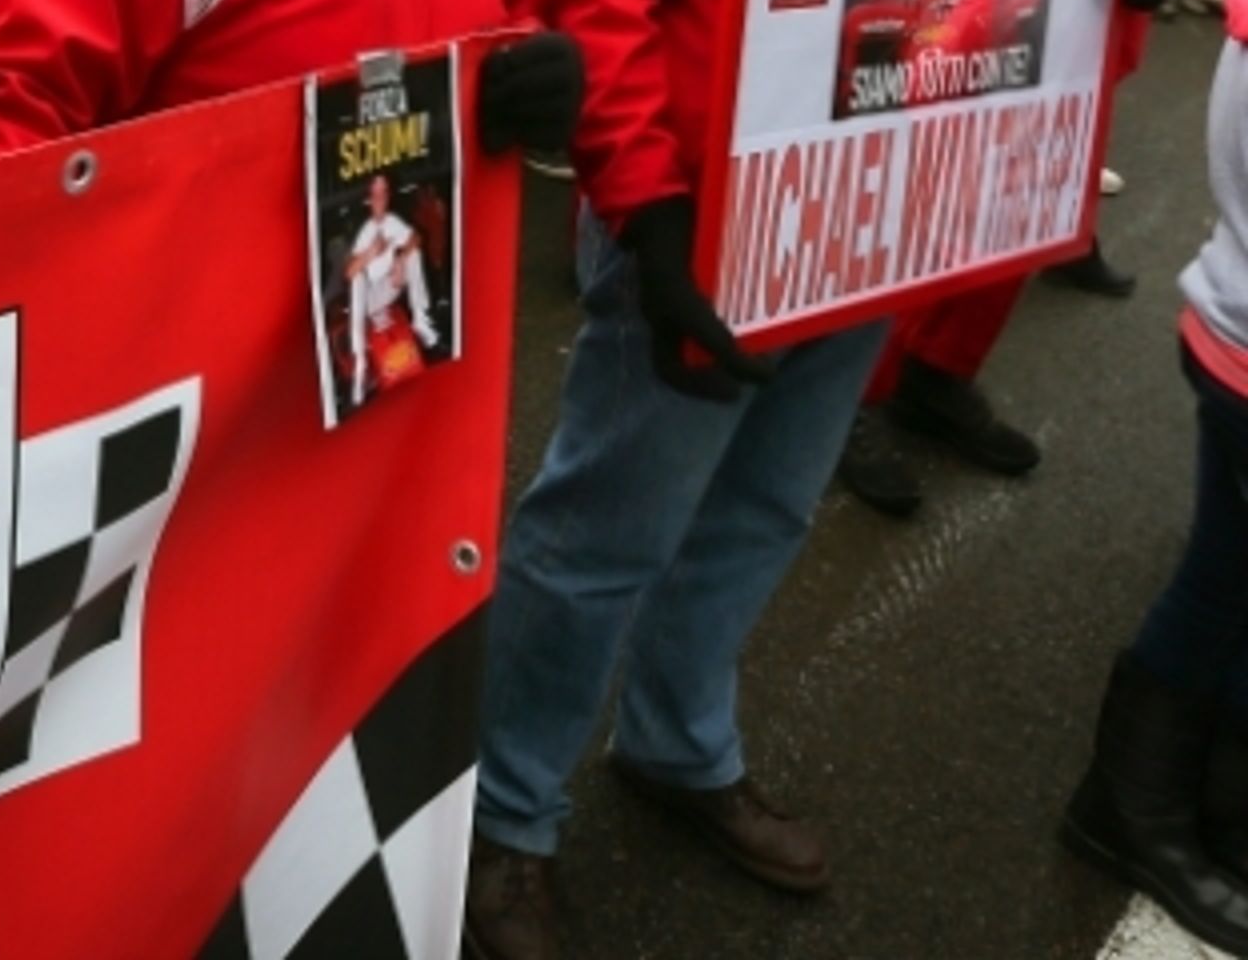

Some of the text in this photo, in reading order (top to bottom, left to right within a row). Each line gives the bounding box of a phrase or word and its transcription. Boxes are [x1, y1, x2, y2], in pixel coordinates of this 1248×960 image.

[338, 111, 430, 179] SCHUMI!
[718, 128, 896, 326] MICHAEL
[895, 108, 993, 282] WIN
